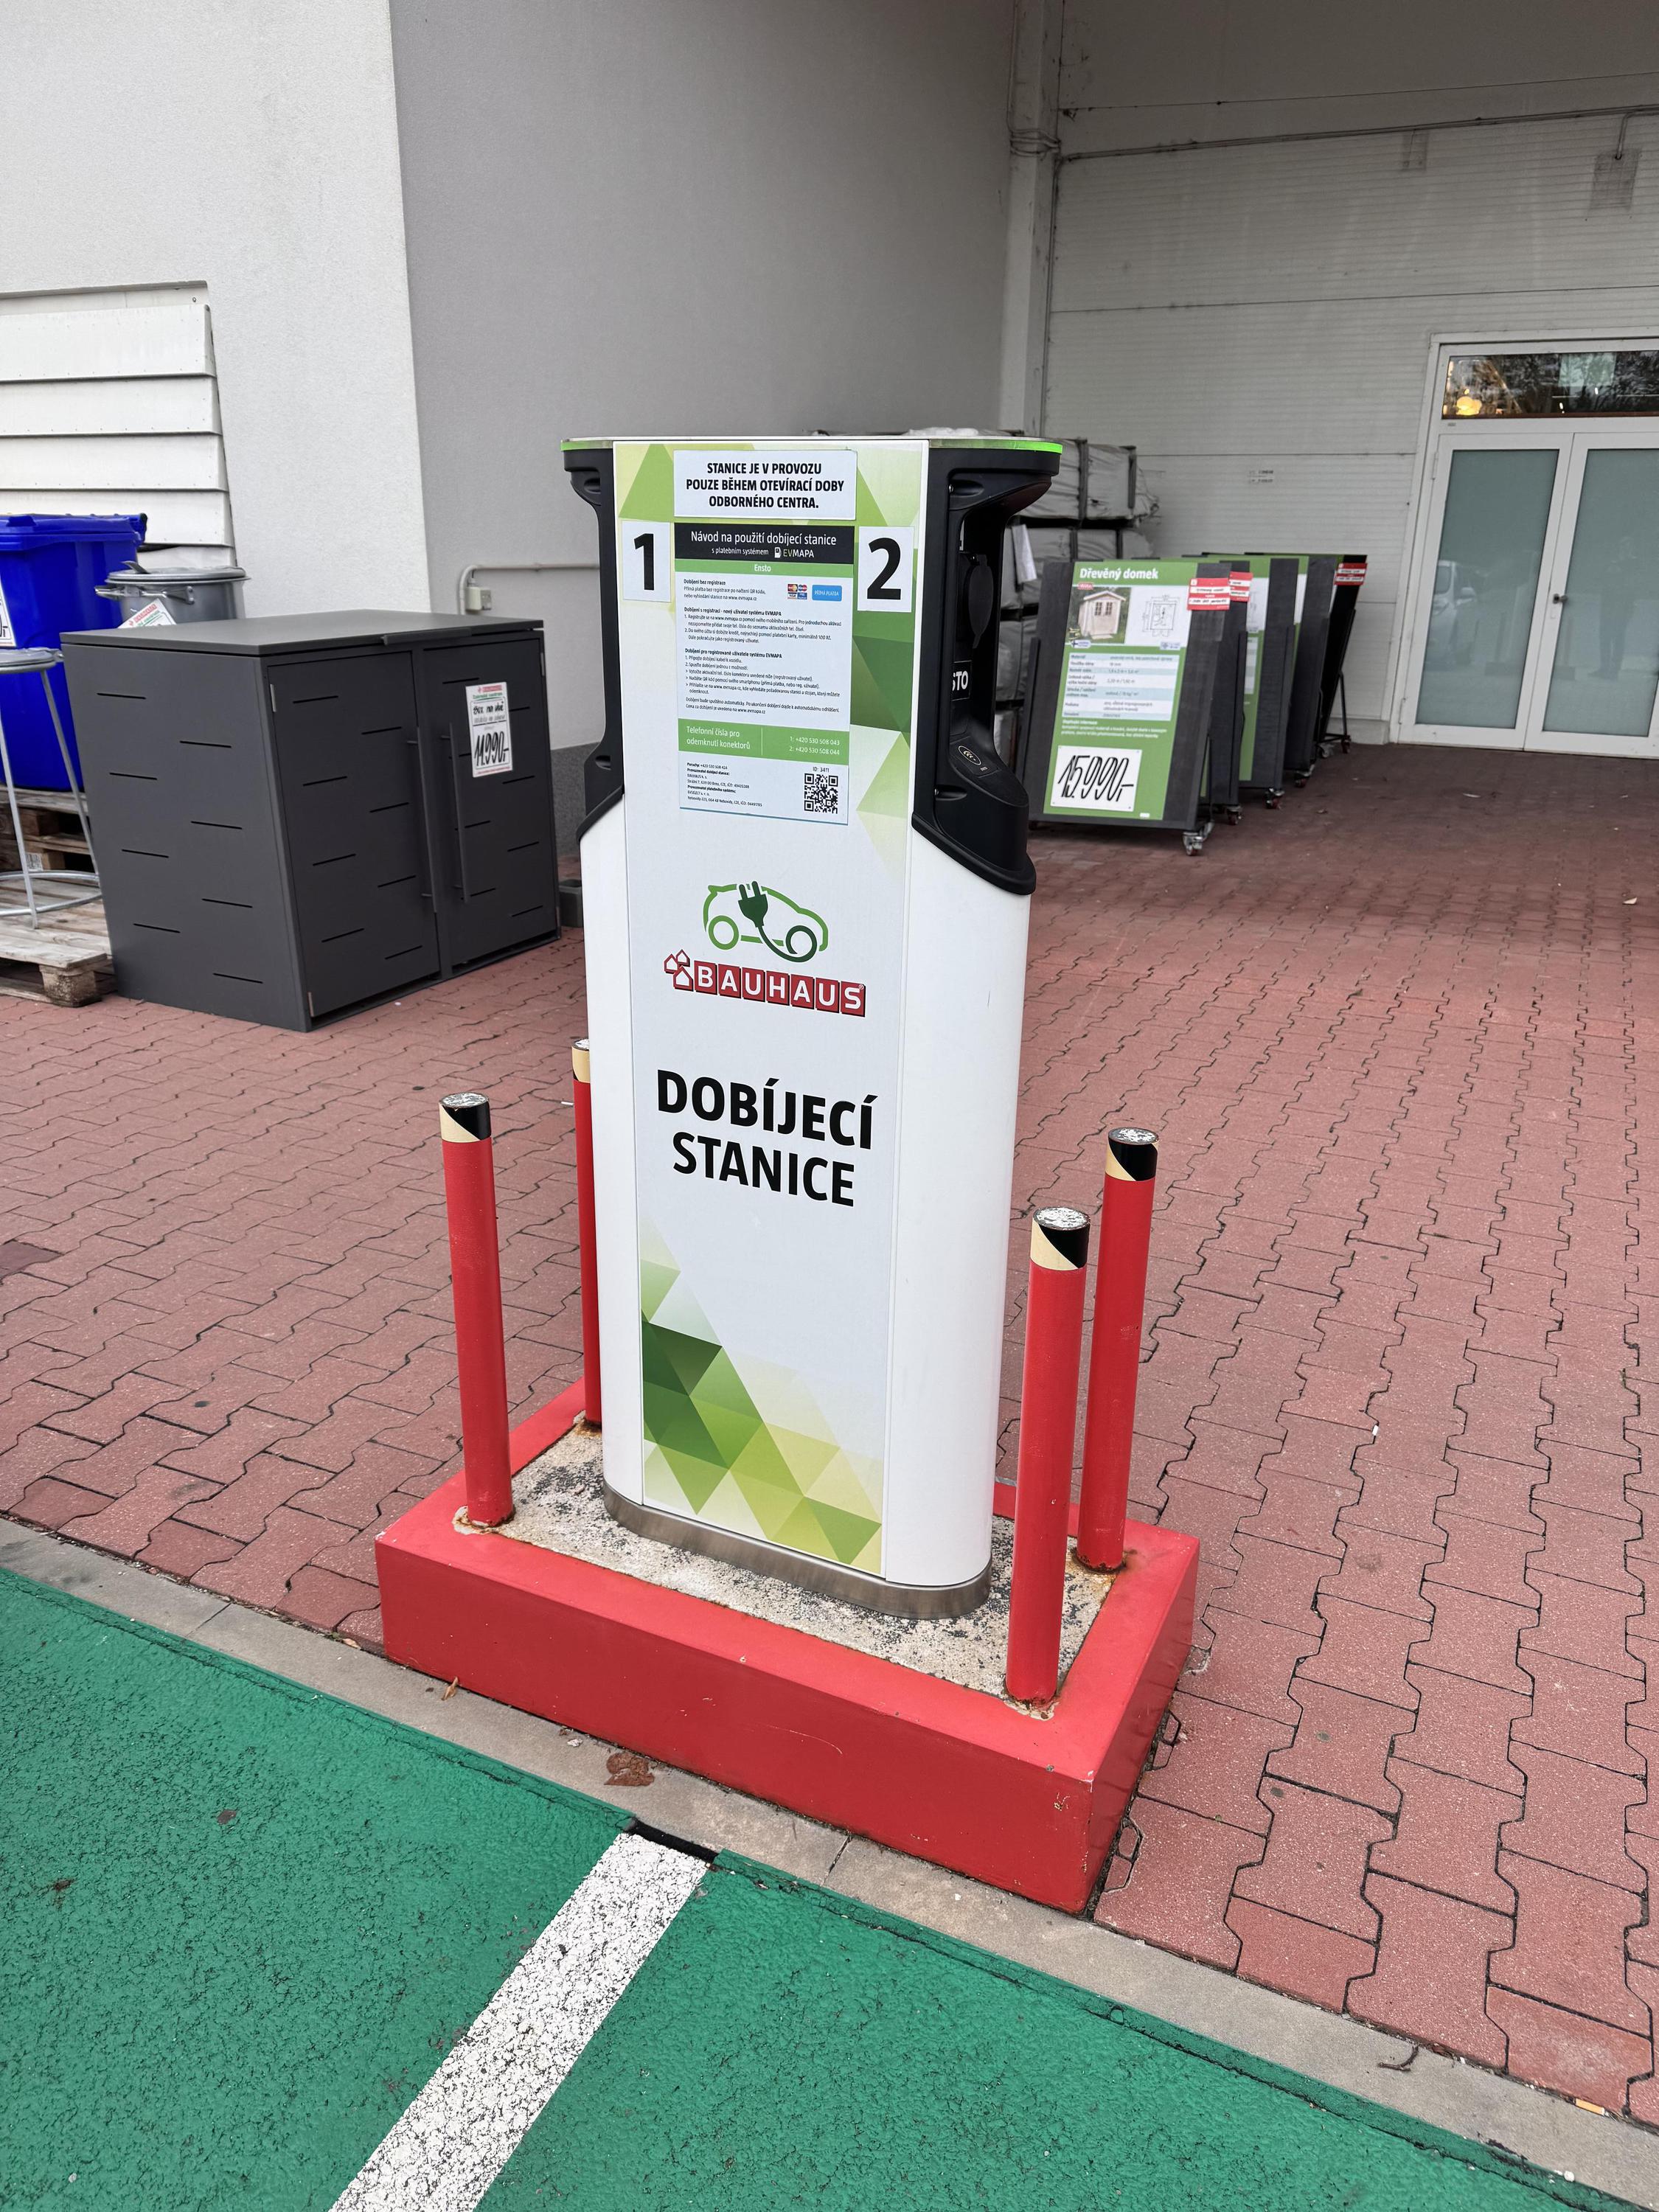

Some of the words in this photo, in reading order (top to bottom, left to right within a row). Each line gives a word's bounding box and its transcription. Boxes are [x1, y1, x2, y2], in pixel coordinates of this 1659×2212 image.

[707, 463, 746, 474] STANICE
[749, 463, 759, 474] JE
[762, 463, 769, 474] V
[772, 463, 821, 475] PROVOZU
[686, 479, 719, 490] POUZE
[722, 477, 757, 491] BĚHEM
[760, 478, 813, 491] OTEVÍRACÍ
[815, 481, 844, 492] DOBY
[709, 494, 774, 507] ODBORNÉHO
[777, 497, 818, 509] CENTRA.
[691, 531, 718, 543] Návod
[721, 534, 731, 543] na
[734, 532, 765, 546] použití
[767, 533, 802, 546] dobíjecí
[804, 535, 836, 546] stanice
[715, 547, 741, 555] platebním
[742, 548, 769, 556] systémem
[783, 549, 814, 558] EVMAPA
[633, 533, 655, 591] 1
[754, 564, 771, 572] Ensto
[866, 538, 901, 600] 2
[1079, 568, 1121, 580] Dřevěný
[1123, 568, 1158, 580] domek
[686, 726, 713, 735] Telefonní
[714, 728, 728, 736] čísla
[686, 737, 718, 747] odemknutí
[720, 739, 750, 749] konektorů
[696, 964, 863, 1011] BAUHAUS
[657, 1069, 878, 1150] DOBÍJECÍ
[672, 1131, 855, 1207] STANICE
